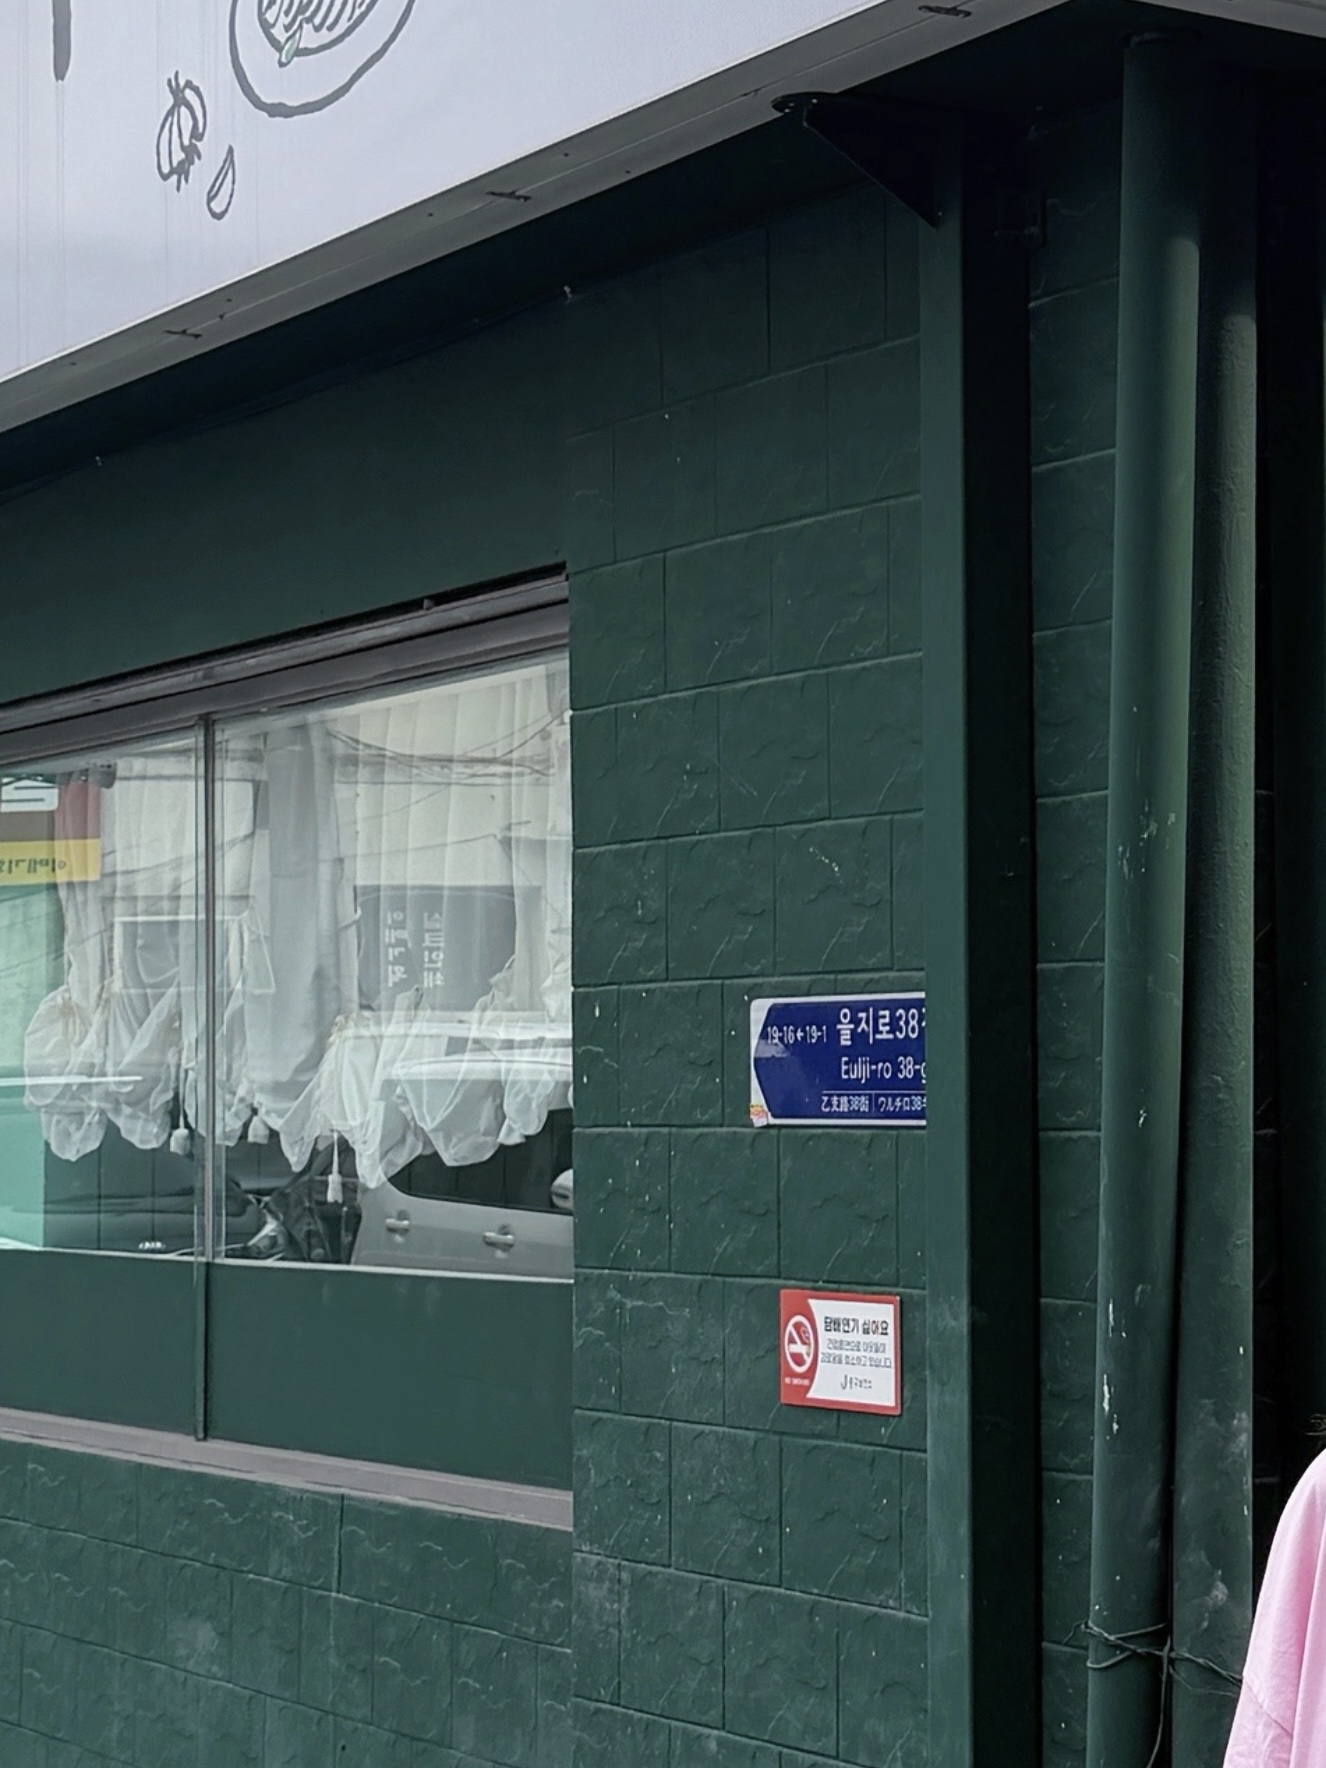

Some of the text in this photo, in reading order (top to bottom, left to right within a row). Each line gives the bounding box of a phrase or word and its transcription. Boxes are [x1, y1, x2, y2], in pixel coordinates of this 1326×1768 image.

[836, 1007, 926, 1046] 을지로38
[841, 1056, 892, 1084] Eulji-ro
[824, 1316, 859, 1334] 담배연기
